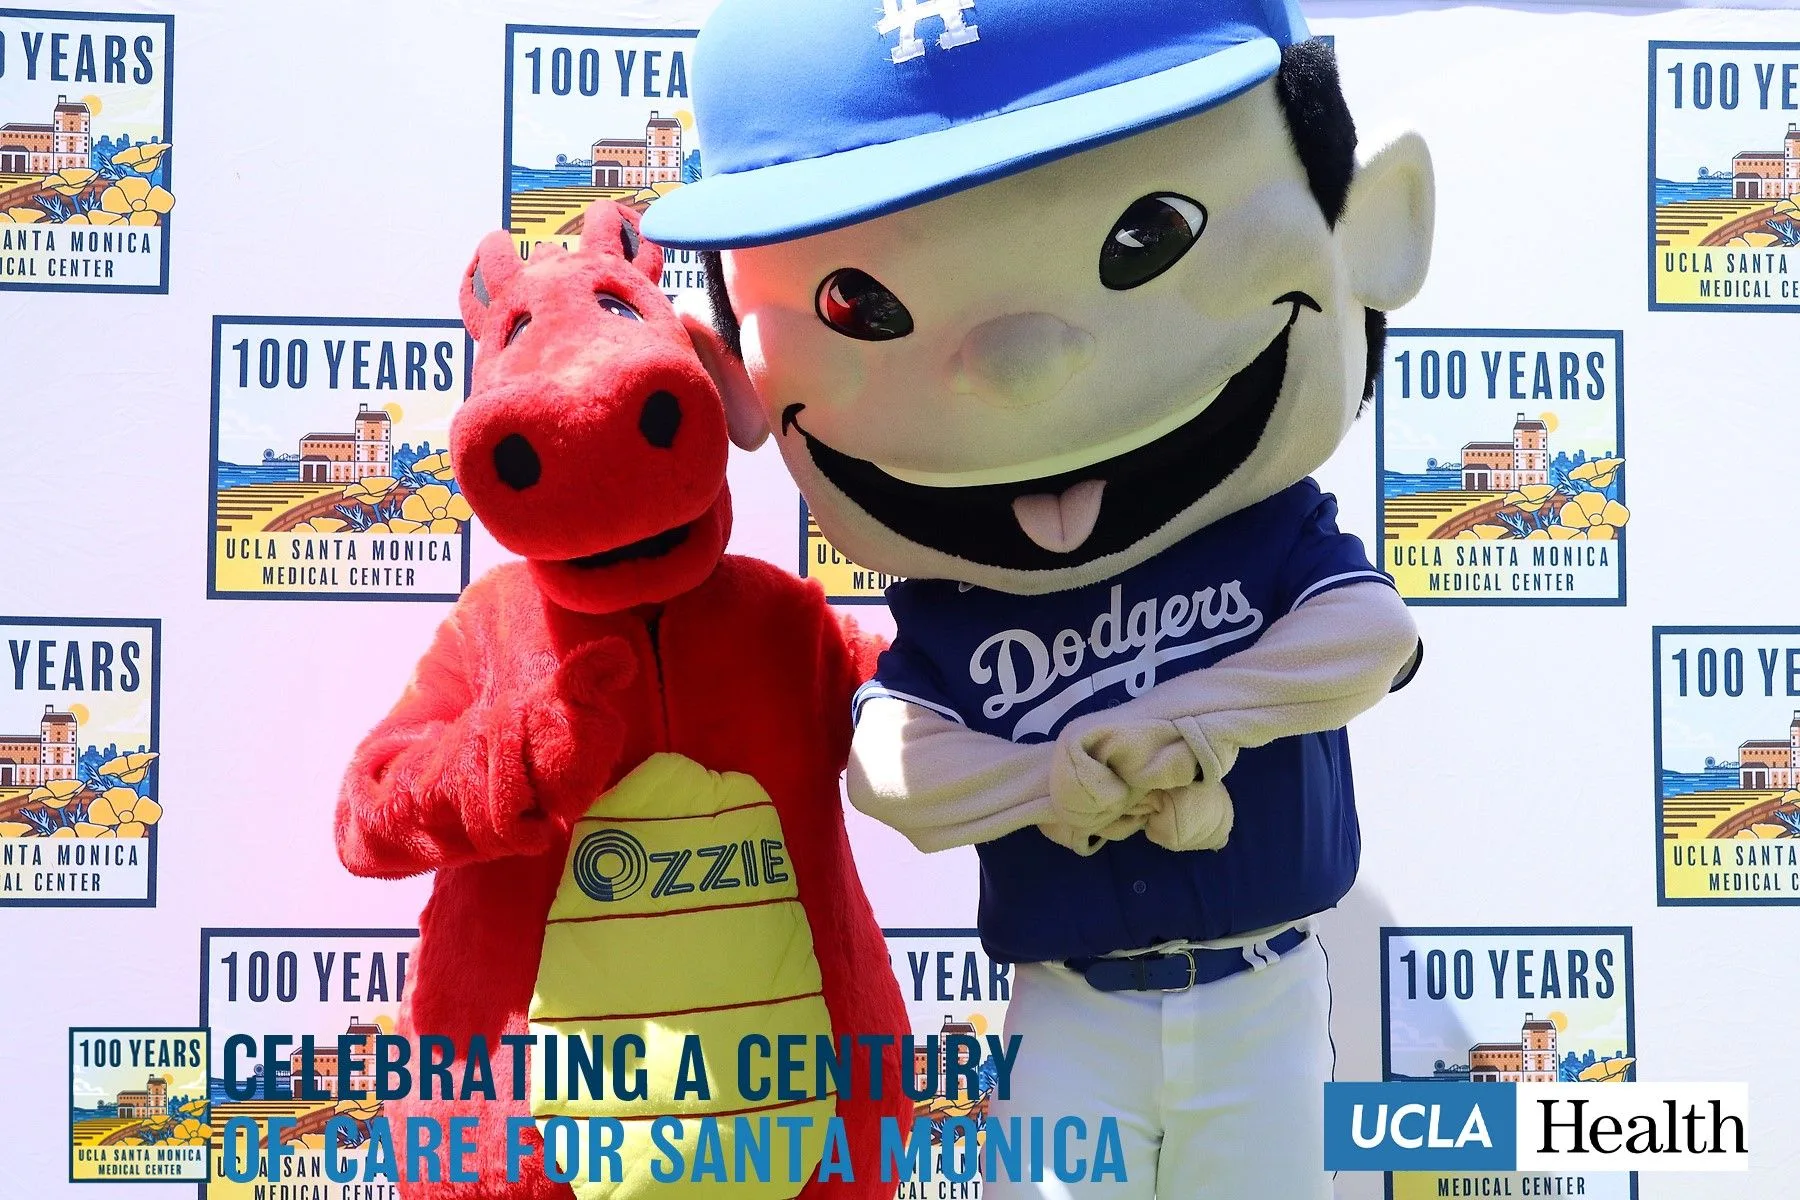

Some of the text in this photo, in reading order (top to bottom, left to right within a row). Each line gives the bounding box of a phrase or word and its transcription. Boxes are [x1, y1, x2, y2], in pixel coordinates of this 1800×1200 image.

[21, 31, 153, 85] YEARS
[525, 47, 689, 98] 100 YEA
[1667, 62, 1739, 110] 100
[3, 229, 151, 253] ANTA MONICA
[48, 258, 114, 277] CENTER
[1665, 252, 1787, 274] UCLA SANTA
[663, 270, 704, 288] NTER
[1700, 280, 1771, 298] MEDICAL
[232, 338, 453, 391] 100 YEARS
[1394, 350, 1605, 400] 100 YEARS
[226, 538, 451, 562] UCLA SANTA MONICA
[1394, 546, 1609, 567] UCLA SANTA MONICA
[262, 566, 415, 586] MEDICAL CENTER
[1429, 573, 1575, 591] MEDICAL CENTER
[969, 579, 1254, 719] Dodgers
[9, 640, 141, 692] YEARS
[1671, 647, 1744, 697] 100
[4, 844, 138, 866] NTA MONICA
[1673, 845, 1797, 866] UCLA SANTA
[34, 872, 101, 892] CENTER
[1709, 873, 1781, 891] MEDICAL
[221, 950, 298, 1002] 100
[907, 951, 1010, 1002] YEAR
[1400, 949, 1615, 1000] 100 YEARS
[342, 1184, 396, 1200] CENTE
[938, 1181, 980, 1200] CENT
[1438, 1177, 1586, 1197] MEDICAL CENTER
